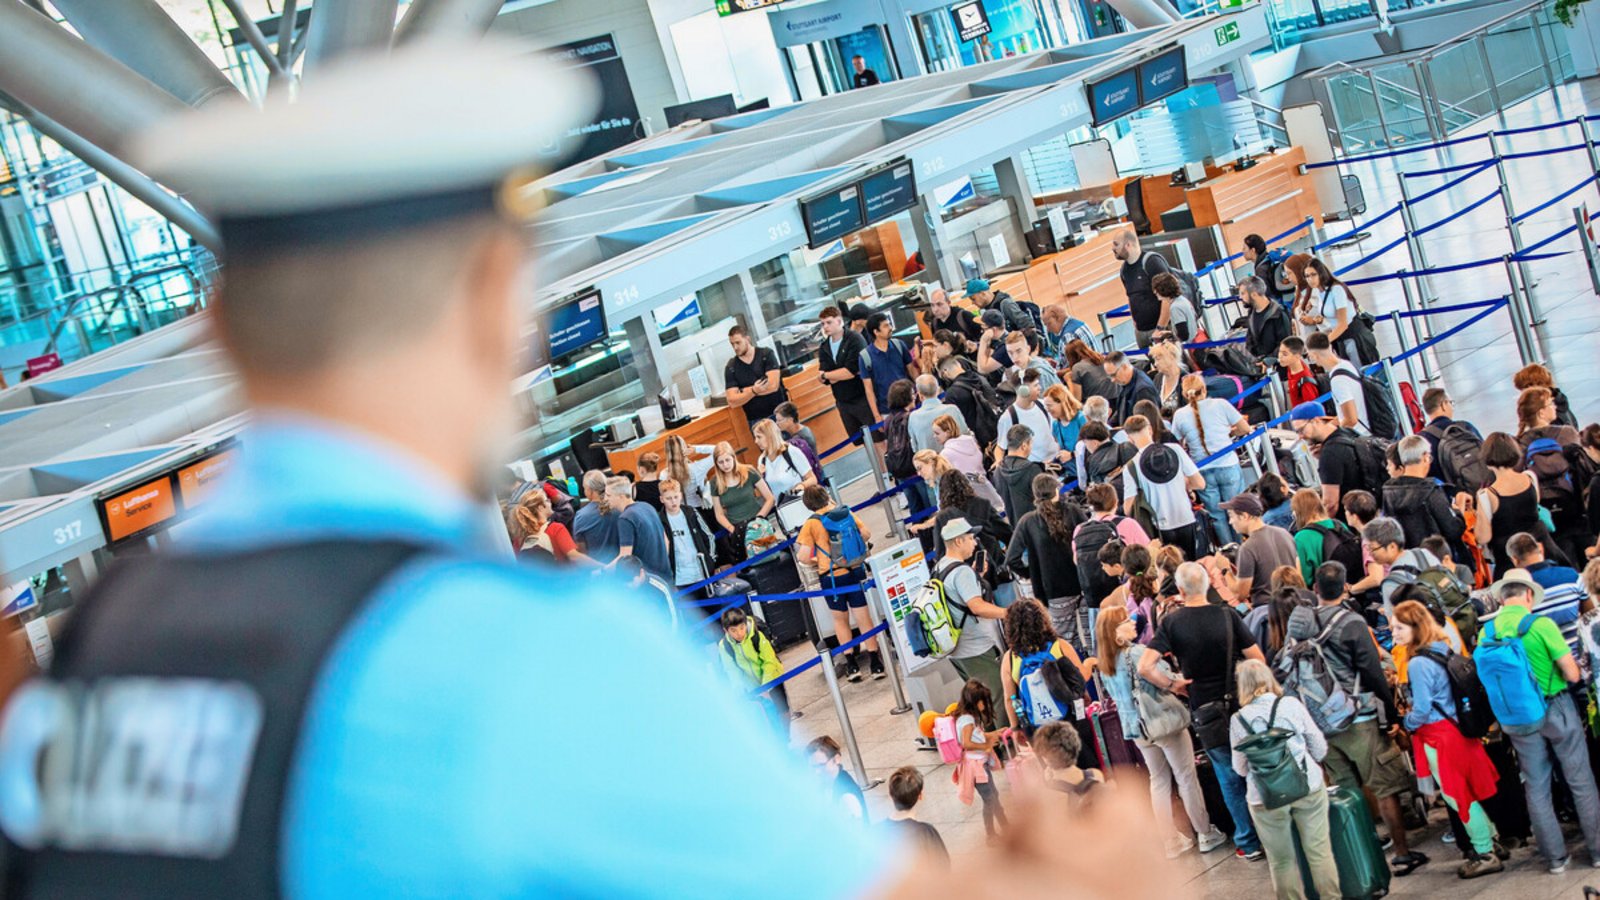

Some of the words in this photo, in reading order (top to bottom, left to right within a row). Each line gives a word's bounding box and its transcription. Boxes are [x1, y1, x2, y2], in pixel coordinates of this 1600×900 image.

[818, 13, 843, 24] AIRPORT
[1061, 102, 1080, 118] 311
[922, 156, 944, 175] 312
[768, 221, 791, 240] 313
[614, 284, 639, 306] 314
[126, 502, 152, 517] Service
[53, 519, 82, 545] 317
[1037, 702, 1053, 719] LA
